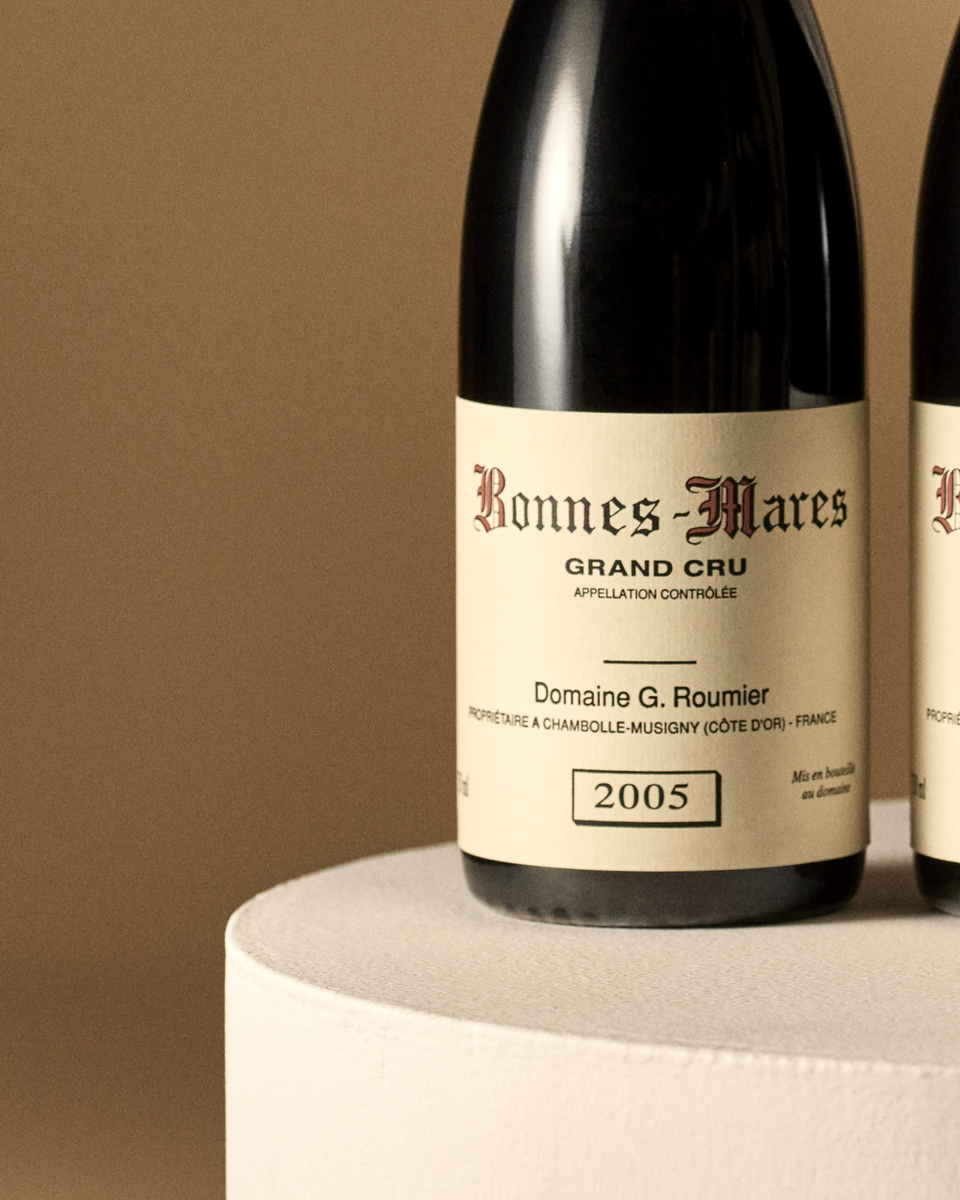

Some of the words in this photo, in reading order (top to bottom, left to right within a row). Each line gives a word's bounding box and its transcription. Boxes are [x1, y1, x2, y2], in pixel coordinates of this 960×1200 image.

[564, 557, 674, 578] GRAND
[683, 556, 748, 578] CRU
[573, 587, 658, 601] APPELLATION
[659, 585, 738, 601] CONTRÔLÉE
[534, 680, 631, 709] Domaine
[637, 685, 666, 709] G.
[673, 683, 771, 709] Roumier
[469, 706, 529, 728] PROPRIÉTAIRE
[542, 717, 700, 735] CHAMBOLLE-MUSIGNY
[703, 717, 748, 737] (CÔTE
[750, 716, 786, 733] D'OR)
[795, 710, 837, 728] FRANCE
[791, 769, 811, 784] Mis
[811, 770, 823, 782] en
[594, 782, 689, 811] 2005
[801, 789, 815, 801] au
